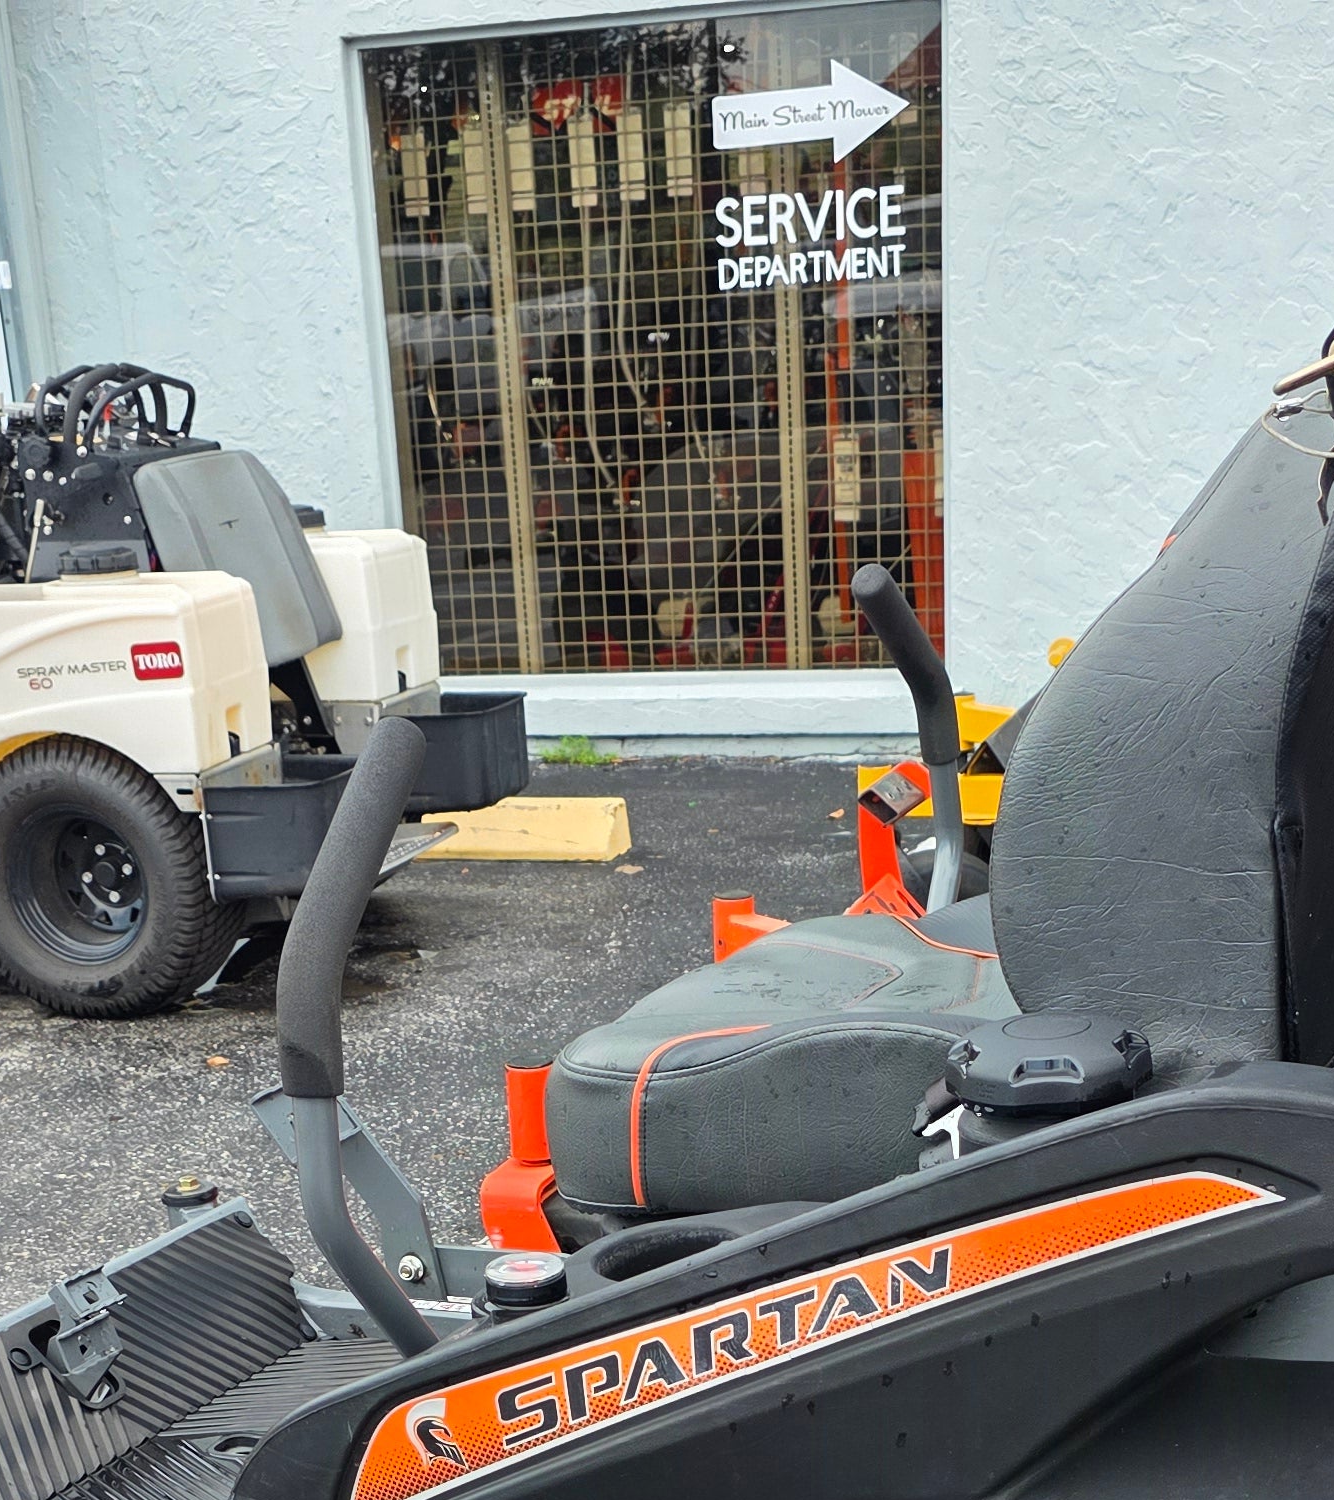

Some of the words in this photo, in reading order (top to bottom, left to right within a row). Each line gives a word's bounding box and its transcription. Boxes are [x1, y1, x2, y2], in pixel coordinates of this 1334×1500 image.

[719, 109, 769, 131] Main
[773, 105, 827, 127] Street
[828, 99, 891, 122] Mower
[715, 184, 906, 248] SERVICE
[718, 244, 906, 291] DEPARTMENT
[17, 665, 64, 679] SPRAY
[67, 660, 127, 676] MASTER
[134, 651, 181, 671] TORO
[28, 678, 53, 690] 60
[498, 1247, 952, 1447] SPARTAN
